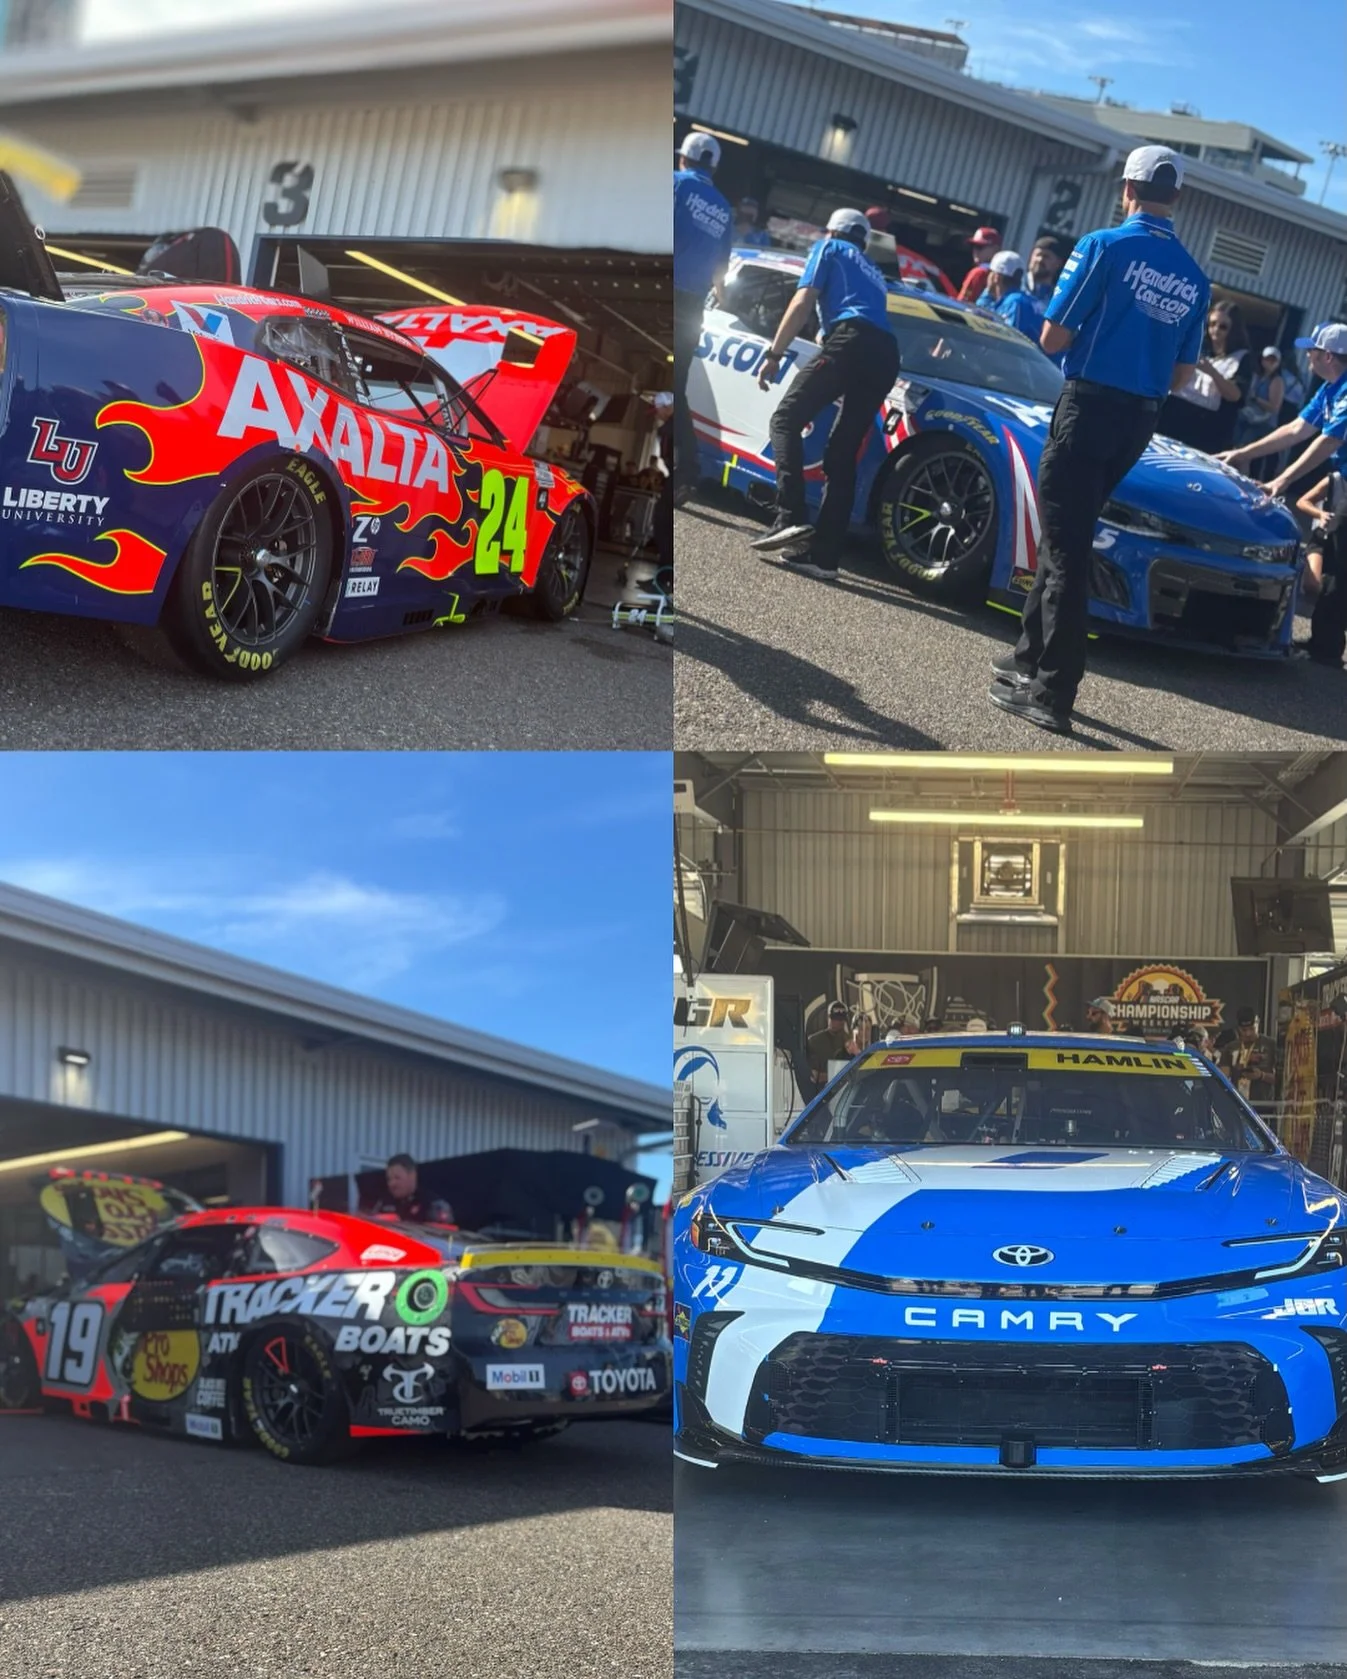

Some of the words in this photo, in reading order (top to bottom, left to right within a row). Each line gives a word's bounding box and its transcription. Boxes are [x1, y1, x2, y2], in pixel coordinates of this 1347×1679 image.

[263, 161, 315, 227] 3
[1123, 260, 1199, 305] Hendrick
[217, 354, 449, 493] AXALTA
[27, 416, 98, 485] LU
[286, 457, 326, 505] EAGLE
[2, 487, 109, 514] LIBERTY
[2, 509, 105, 526] UNIVERSITY
[475, 469, 530, 575] 24
[351, 581, 377, 593] RELAY
[1110, 1004, 1211, 1020] CHAMPIONSHIP
[1057, 1053, 1186, 1070] HAMLIN
[204, 1270, 397, 1324] TRACKER
[692, 1265, 738, 1298] 11
[567, 1303, 632, 1324] TRACKER
[904, 1307, 1138, 1332] CAMRY
[47, 1302, 103, 1384] 19
[335, 1325, 451, 1356] BOATS
[143, 1354, 189, 1394] Shops
[492, 1370, 527, 1384] Mobil
[589, 1368, 656, 1393] TOYOTA
[391, 1416, 431, 1426] CAMO
